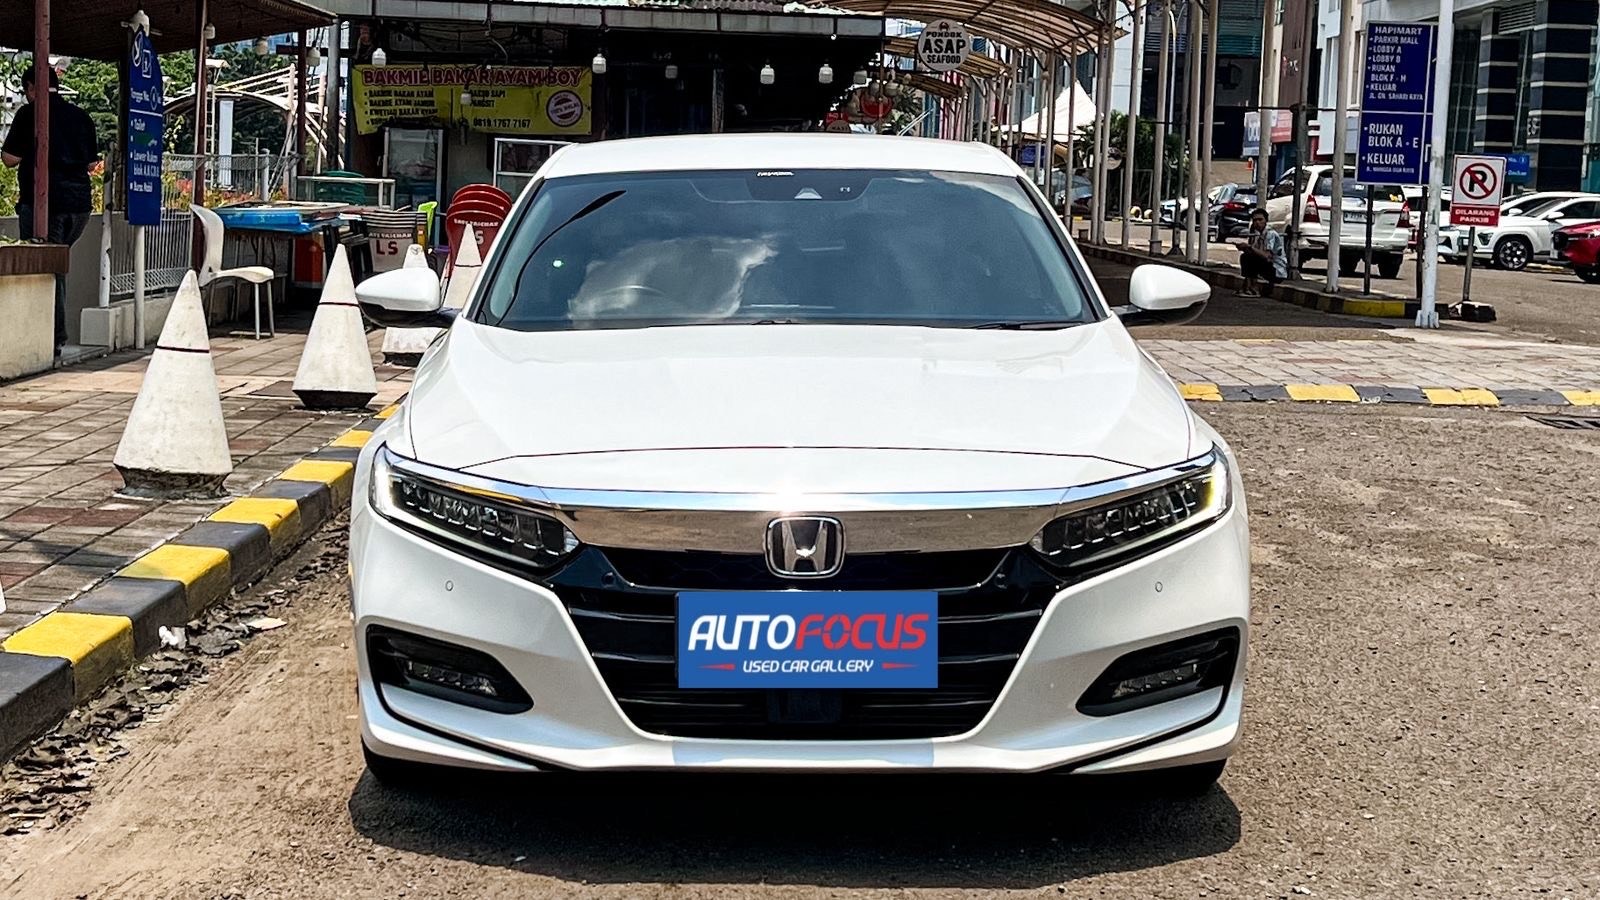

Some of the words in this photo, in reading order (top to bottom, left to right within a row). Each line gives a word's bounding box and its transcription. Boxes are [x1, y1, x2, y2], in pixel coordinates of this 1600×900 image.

[1375, 26, 1423, 35] HAPIMART
[1373, 36, 1399, 44] PARKIR
[1399, 37, 1419, 45] MALL
[922, 38, 967, 54] ASAP
[1372, 45, 1396, 53] LOBBY
[1396, 46, 1402, 54] A
[926, 54, 961, 64] SEAFOOD
[1372, 55, 1395, 63] LOBBY
[1371, 64, 1396, 72] RUKAN
[363, 68, 430, 86] BAKMIE
[431, 67, 490, 86] BAKAR
[494, 68, 542, 87] AYAM
[544, 67, 582, 87] BOY
[1370, 73, 1389, 82] BLOK
[1369, 83, 1397, 91] KELUAR
[1368, 123, 1404, 136] RUKAN
[1368, 136, 1394, 148] BLOK
[1395, 136, 1403, 148] A
[1412, 137, 1419, 149] E
[1366, 153, 1405, 165] KELUAR
[1455, 208, 1496, 217] DILARANG
[1459, 216, 1490, 224] PARKIR
[376, 239, 399, 256] LS
